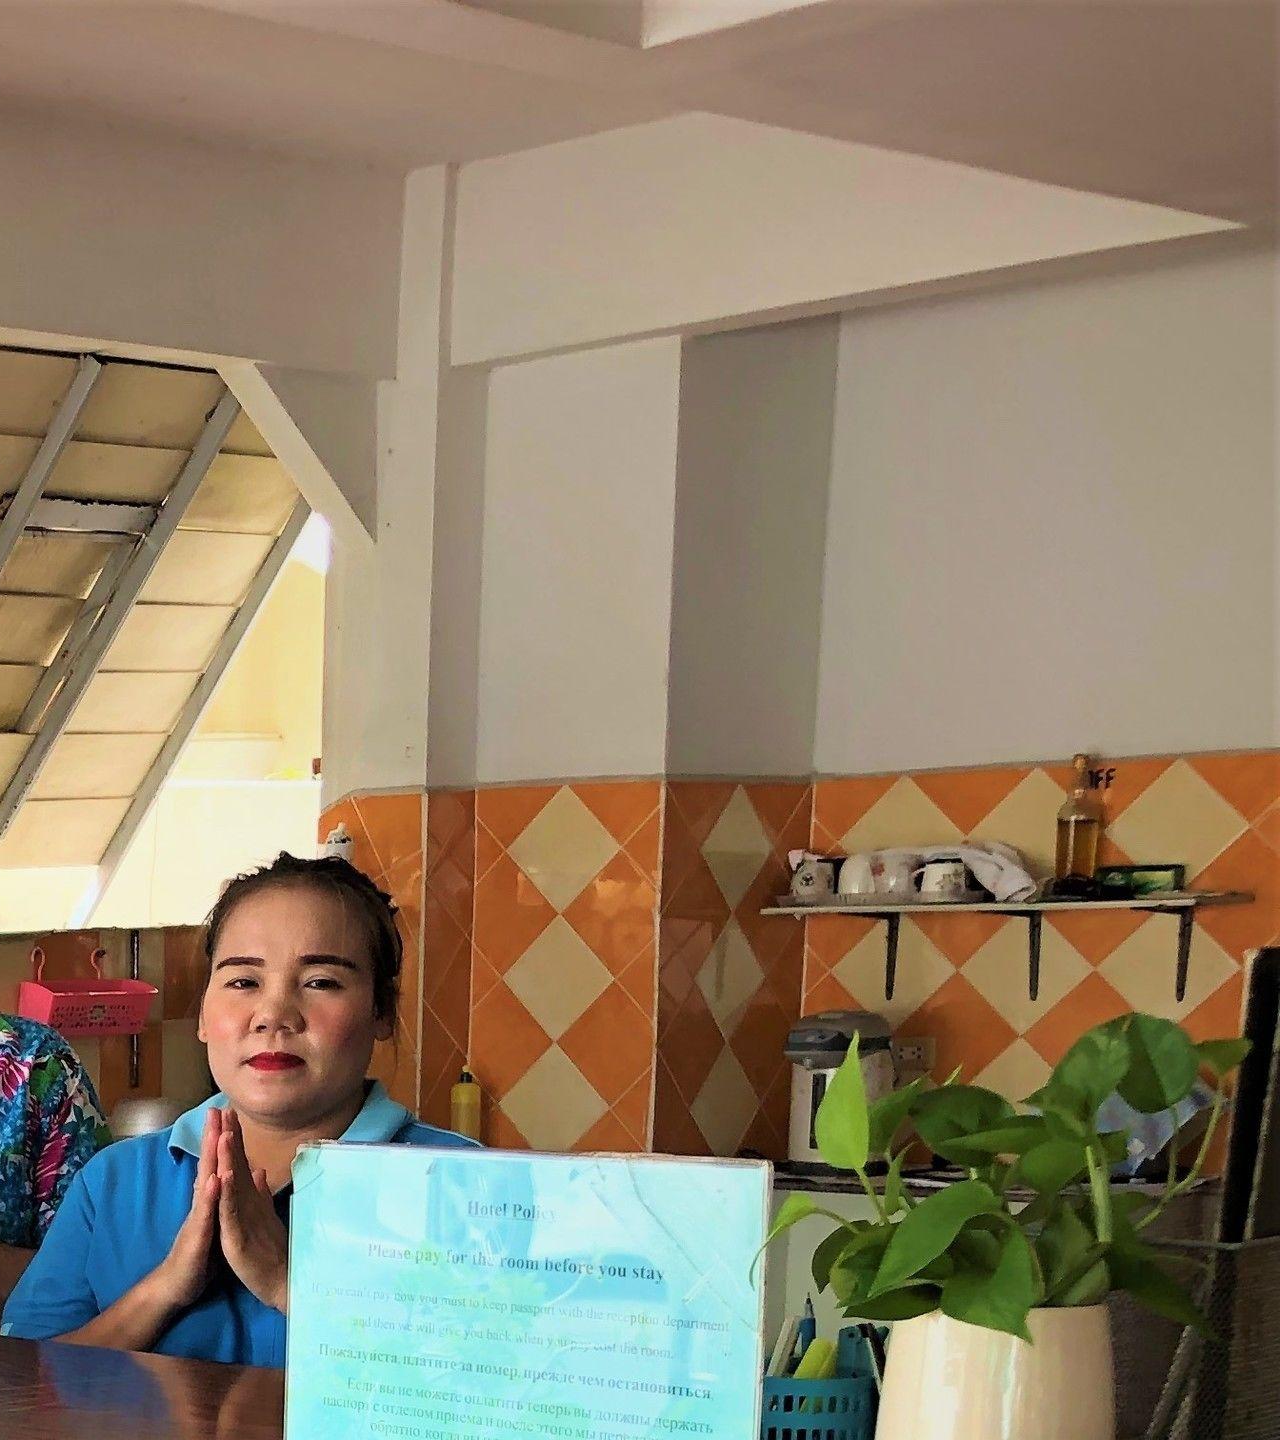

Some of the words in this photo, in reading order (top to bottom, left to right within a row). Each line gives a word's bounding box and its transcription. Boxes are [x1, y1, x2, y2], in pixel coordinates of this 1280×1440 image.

[466, 1200, 507, 1217] Hotel
[511, 1202, 557, 1221] Policy
[368, 1242, 412, 1260] Please
[414, 1248, 441, 1266] pay
[445, 1247, 467, 1264] for
[471, 1249, 495, 1267] the
[499, 1255, 539, 1271] room
[543, 1256, 594, 1276] before
[598, 1263, 627, 1280] you
[631, 1264, 665, 1285] stay
[394, 1291, 415, 1303] now
[418, 1293, 437, 1307] you
[441, 1295, 466, 1307] must
[468, 1297, 480, 1309] to
[481, 1297, 507, 1313] keep
[510, 1302, 555, 1318] passport
[662, 1313, 729, 1334] department
[416, 1321, 434, 1333] will
[463, 1327, 483, 1342] you
